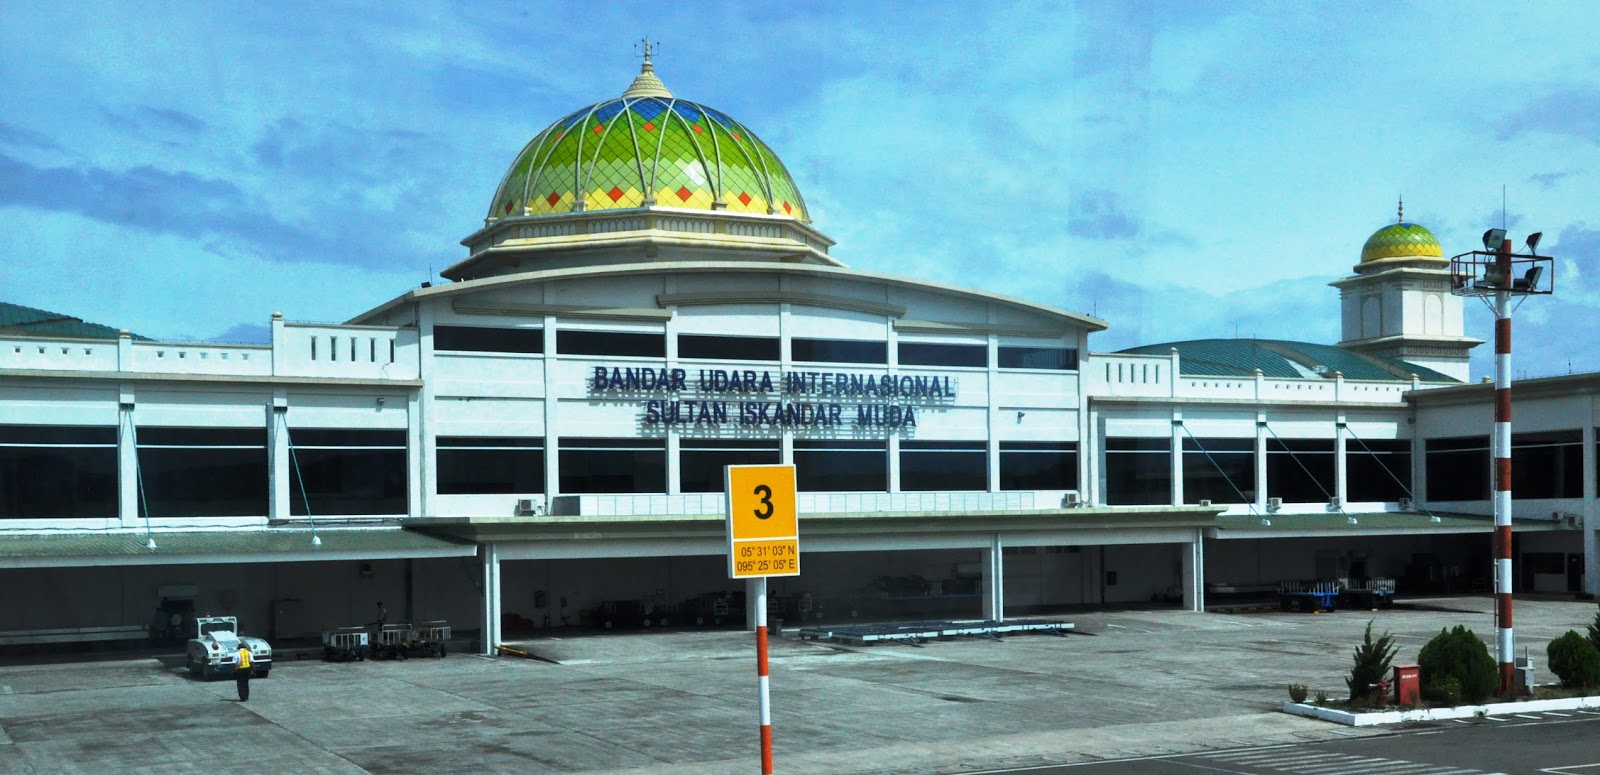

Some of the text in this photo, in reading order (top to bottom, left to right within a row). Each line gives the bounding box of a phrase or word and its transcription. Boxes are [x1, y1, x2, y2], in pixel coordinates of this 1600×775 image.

[594, 366, 956, 398] BANDAR UDARA INTERNASIONAL
[647, 400, 917, 427] SULTAN ISKANDAR MUDA
[753, 484, 774, 520] 3
[787, 545, 795, 555] N
[789, 558, 795, 569] E
